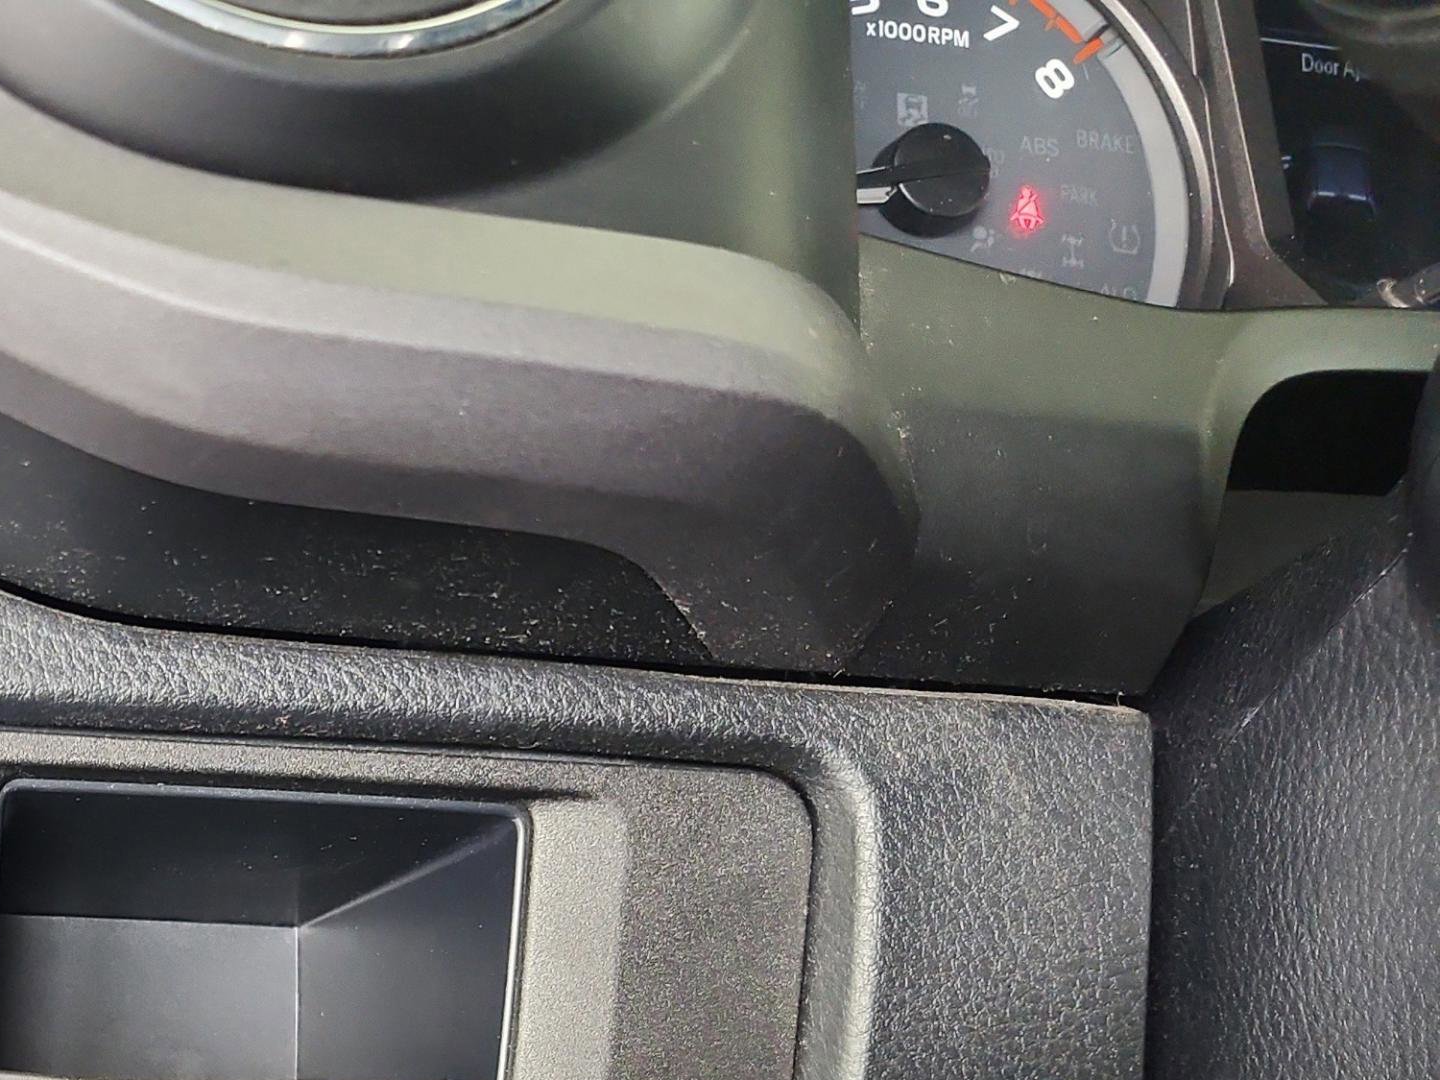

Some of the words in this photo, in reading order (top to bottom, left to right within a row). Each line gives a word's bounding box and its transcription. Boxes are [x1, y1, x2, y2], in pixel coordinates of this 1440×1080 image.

[983, 4, 1020, 41] 7
[1301, 53, 1340, 75] Door
[1034, 58, 1075, 99] 8
[1019, 136, 1060, 157] ABS
[1076, 128, 1135, 154] BRAKE
